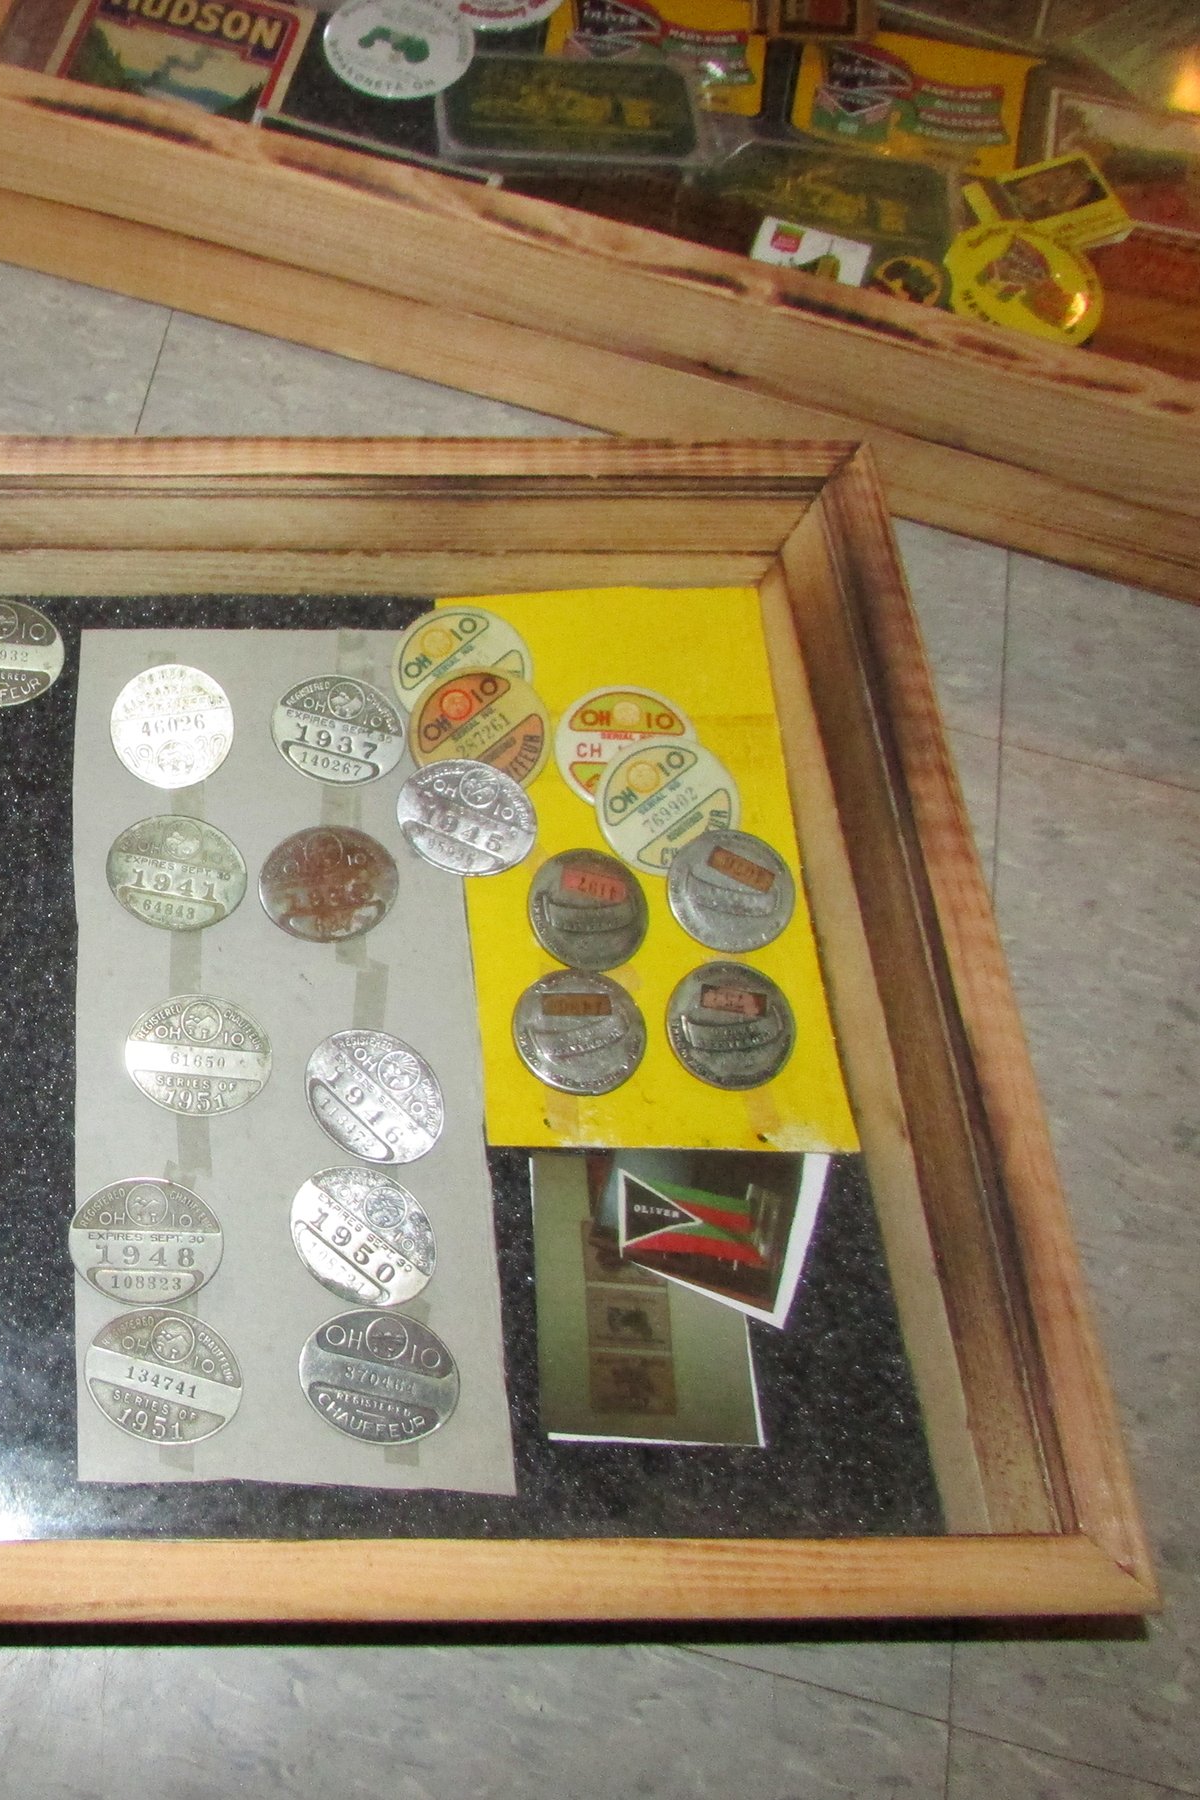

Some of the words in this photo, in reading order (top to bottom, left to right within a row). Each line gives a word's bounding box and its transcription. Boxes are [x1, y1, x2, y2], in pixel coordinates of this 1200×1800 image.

[111, 0, 282, 49] UDSON
[141, 714, 206, 737] 46026
[286, 709, 336, 730] EXPIRES
[295, 722, 379, 759] 1937
[300, 750, 362, 777] 140267
[125, 854, 175, 871] EXPIRES
[131, 868, 218, 901] 1941
[142, 899, 195, 920] 64843
[136, 1003, 182, 1039] REGISTERED
[223, 1009, 264, 1050] CHAUFFEUR
[339, 1036, 394, 1052] REGISTERED
[170, 1052, 226, 1069] 61650
[335, 1052, 375, 1093] EXPIRES
[155, 1075, 211, 1089] SERIES
[218, 1081, 238, 1092] OF
[163, 1089, 228, 1111] 1951
[326, 1063, 401, 1144] 1946
[80, 1188, 126, 1228] REGISTERED
[169, 1190, 214, 1230] CHAUFFEUR
[633, 1204, 680, 1218] OLIVER
[88, 1232, 143, 1242] EXPIRES
[150, 1233, 183, 1243] SEPT.
[188, 1235, 205, 1244] 30
[310, 1208, 396, 1283] 1950
[318, 1192, 364, 1233] EXPIRES
[396, 1258, 412, 1273] 30
[95, 1245, 195, 1267] 1948
[102, 1315, 155, 1345] REGISTERED
[198, 1331, 234, 1383] CHAUFFEUR
[126, 1365, 197, 1399] 134741
[113, 1390, 170, 1415] SERIES
[179, 1410, 196, 1421] OF
[318, 1392, 426, 1438] CHAUFFEUR
[336, 1391, 411, 1417] REGISTERED
[116, 1408, 183, 1440] 1951
